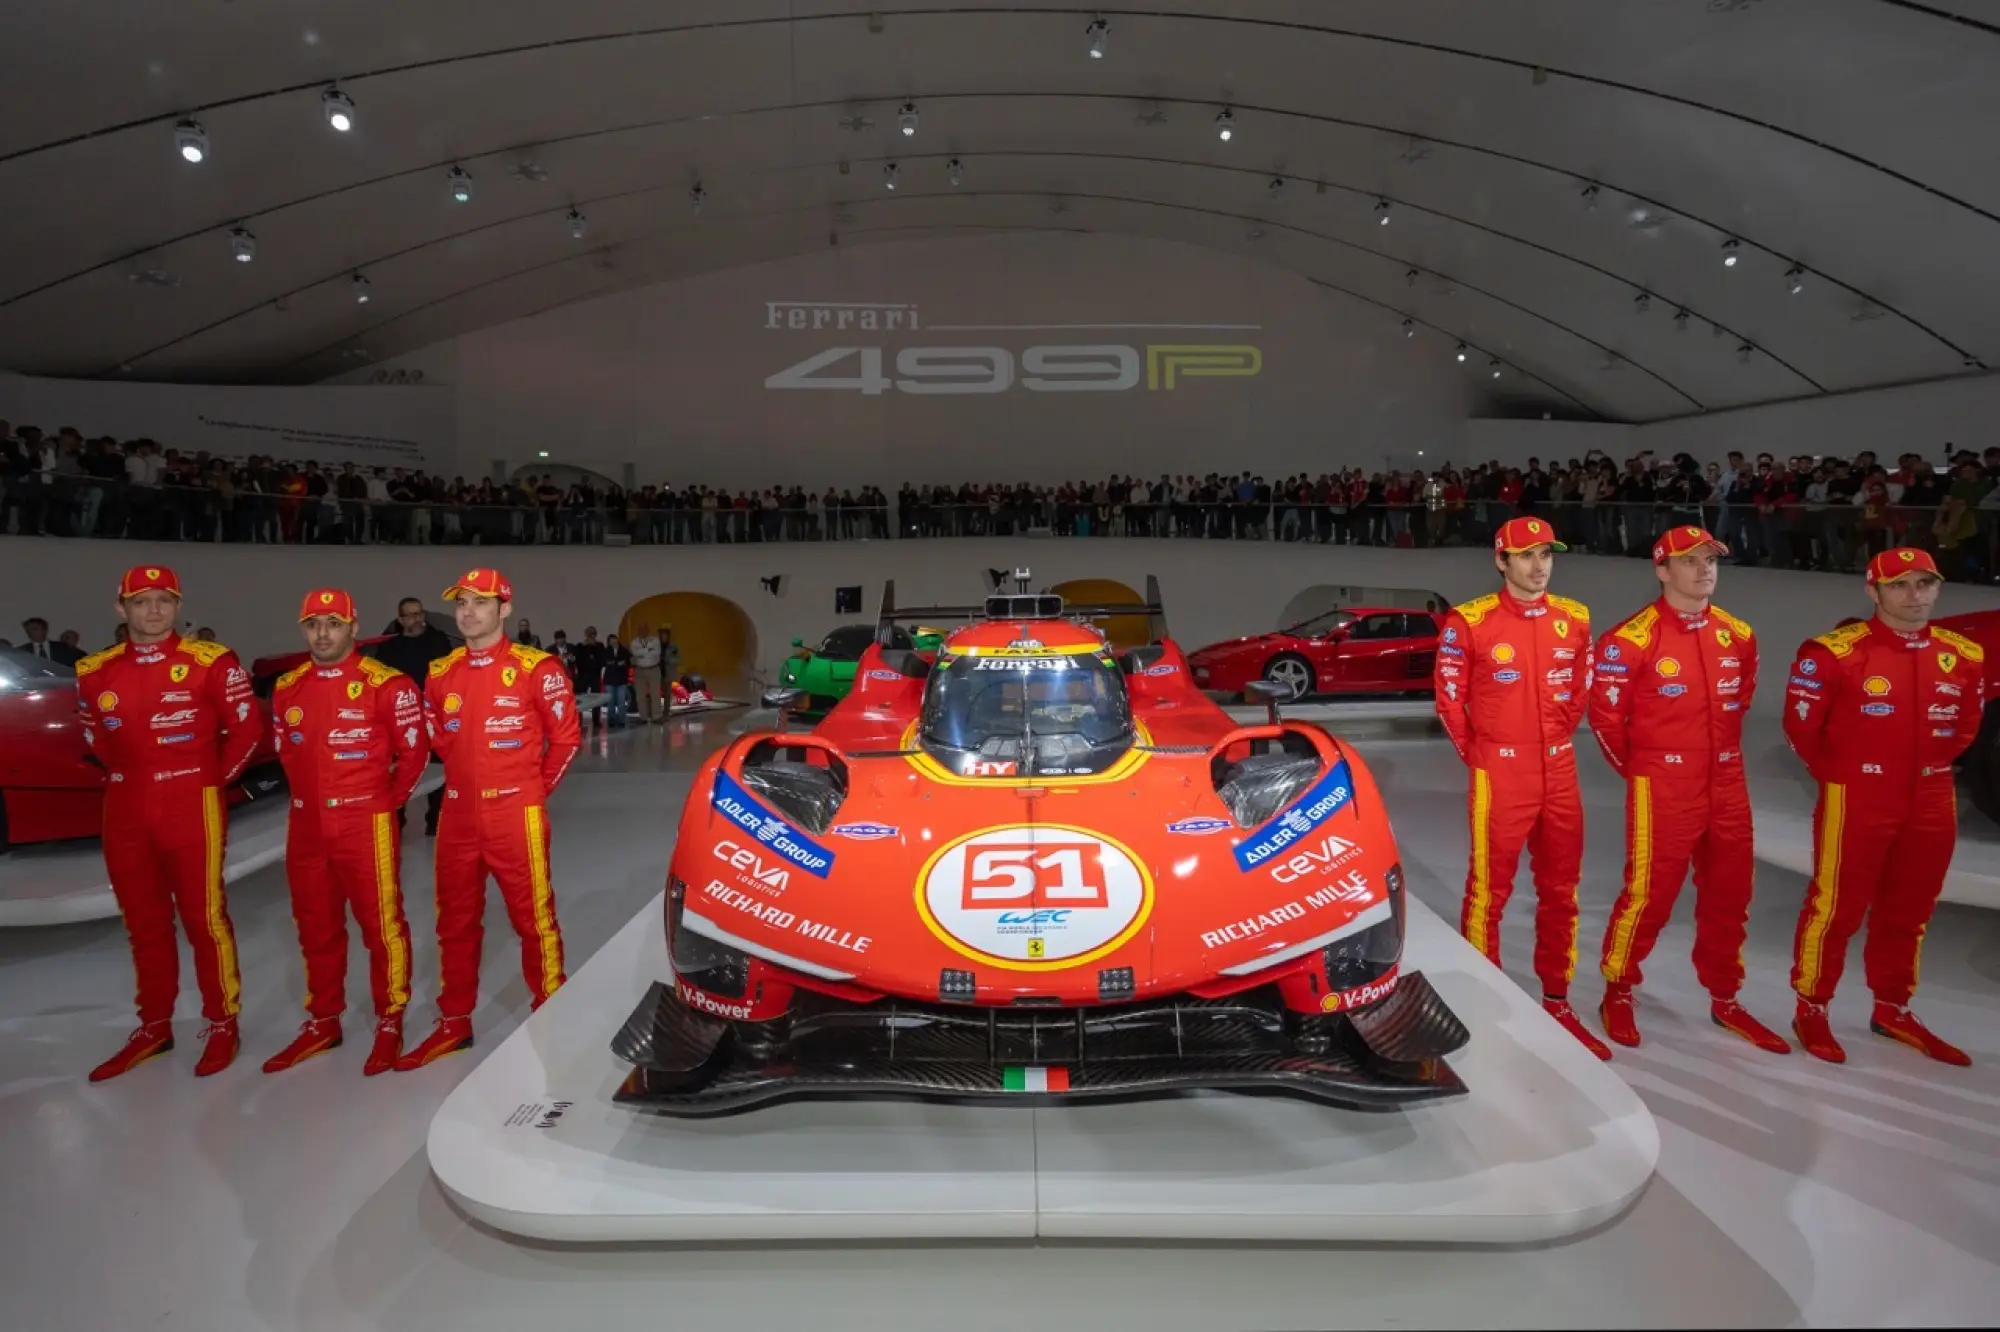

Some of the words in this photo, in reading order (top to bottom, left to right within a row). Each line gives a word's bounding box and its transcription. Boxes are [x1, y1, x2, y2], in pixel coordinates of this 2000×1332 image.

[764, 302, 919, 330] Ferrari
[764, 344, 1262, 395] 499P
[973, 655, 1080, 670] Ferrari
[716, 797, 762, 833] ADLER
[774, 837, 826, 870] GROUP
[1245, 828, 1297, 865] ADLER
[1305, 786, 1348, 822] GROUP
[971, 850, 1098, 900] 51
[704, 879, 796, 929] RICHARD
[796, 919, 872, 953] MILLE
[998, 910, 1072, 923] WEC
[1200, 901, 1306, 948] RICHARD
[1304, 869, 1368, 910] MILLE
[683, 984, 752, 1019] V-Power
